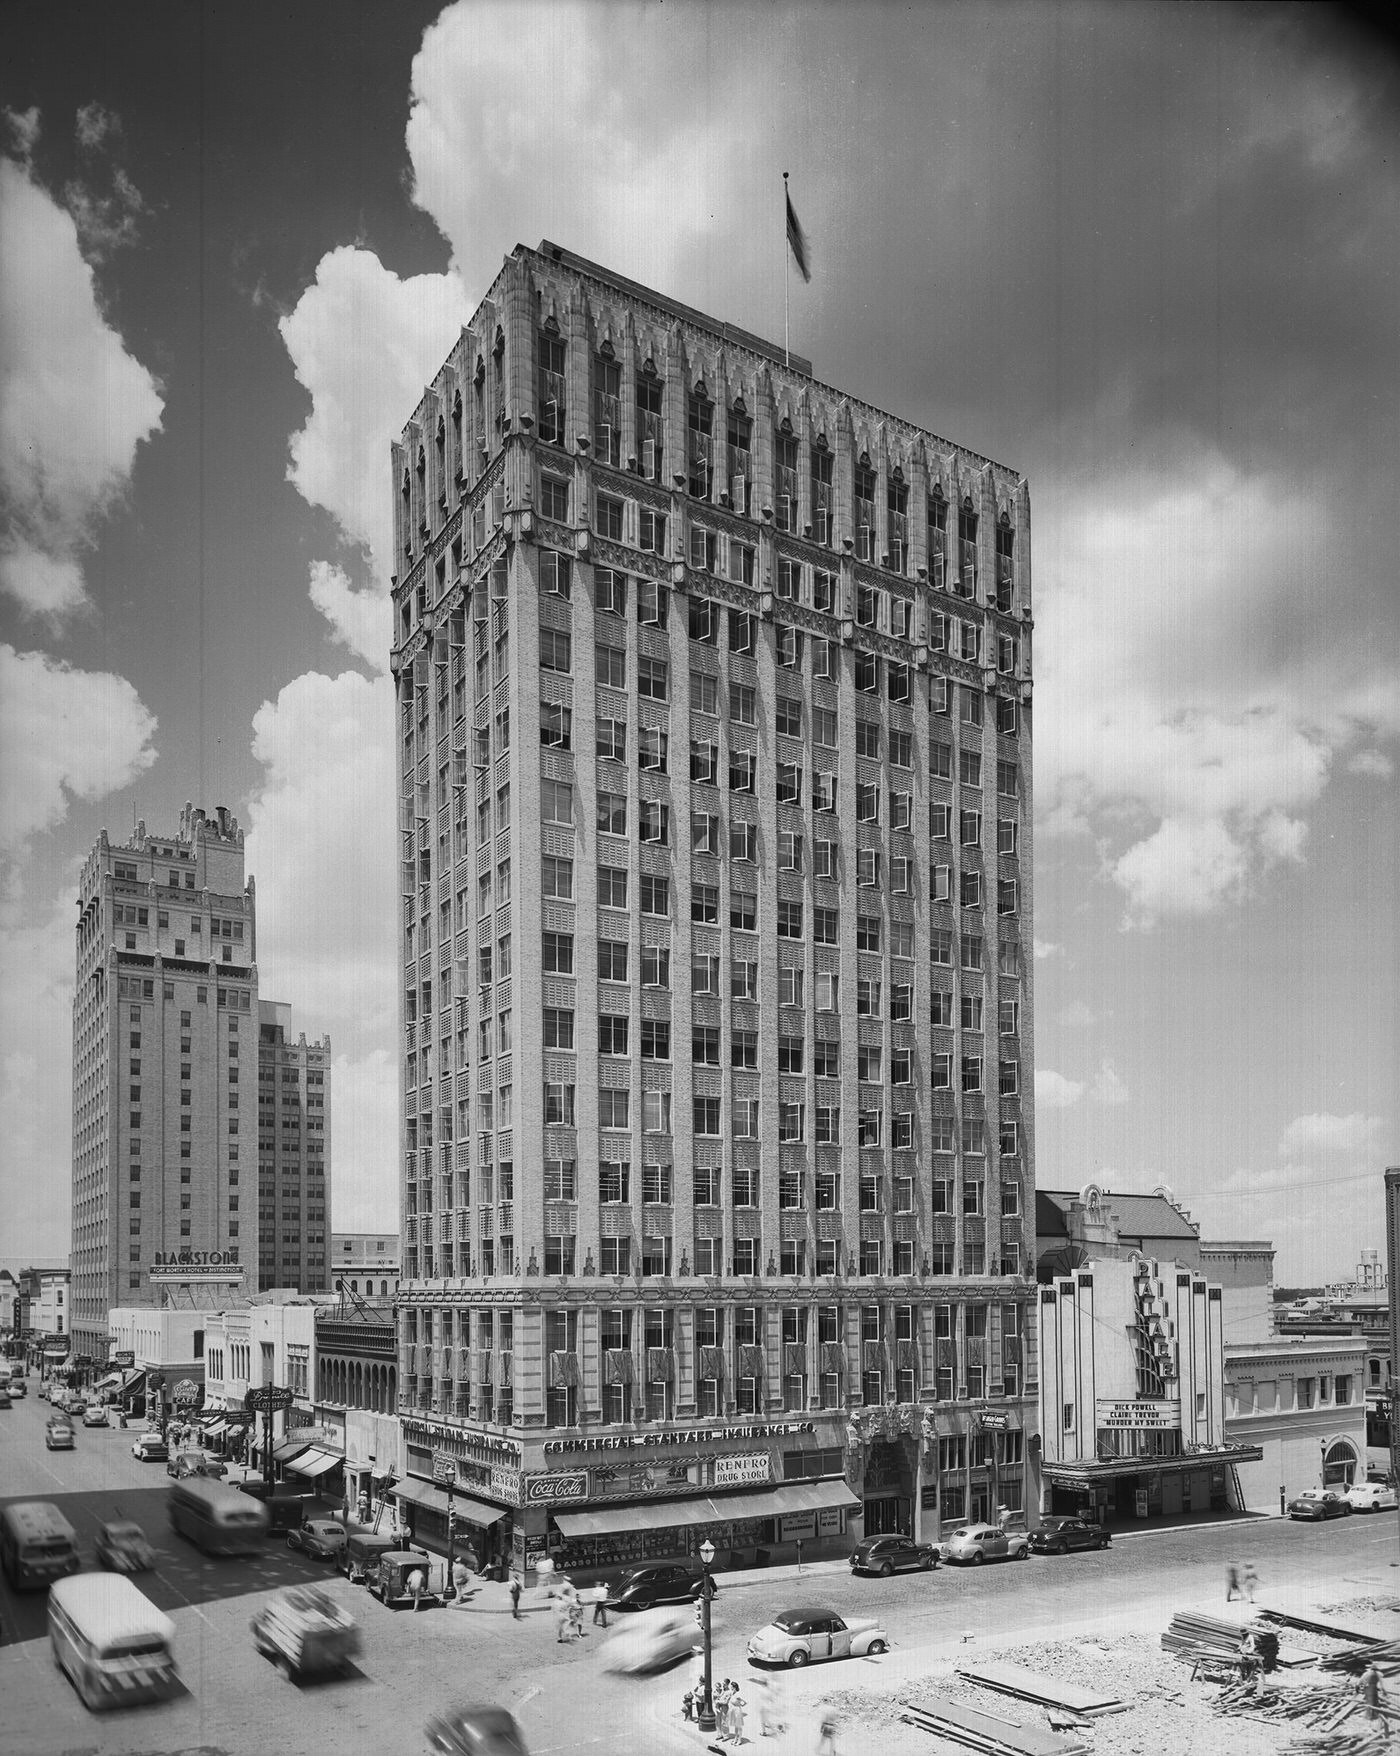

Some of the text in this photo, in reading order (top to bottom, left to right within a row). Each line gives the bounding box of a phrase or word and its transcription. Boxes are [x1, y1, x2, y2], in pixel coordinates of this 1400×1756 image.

[155, 1251, 239, 1265] BLACKSTONE
[1138, 1261, 1174, 1377] PALACE
[543, 1435, 635, 1454] COMMERCIAL
[643, 1430, 713, 1446] STANDARD
[721, 1424, 790, 1440] INSURANCE
[717, 1458, 767, 1472] RENFRO
[717, 1470, 767, 1482] DRUG STORE
